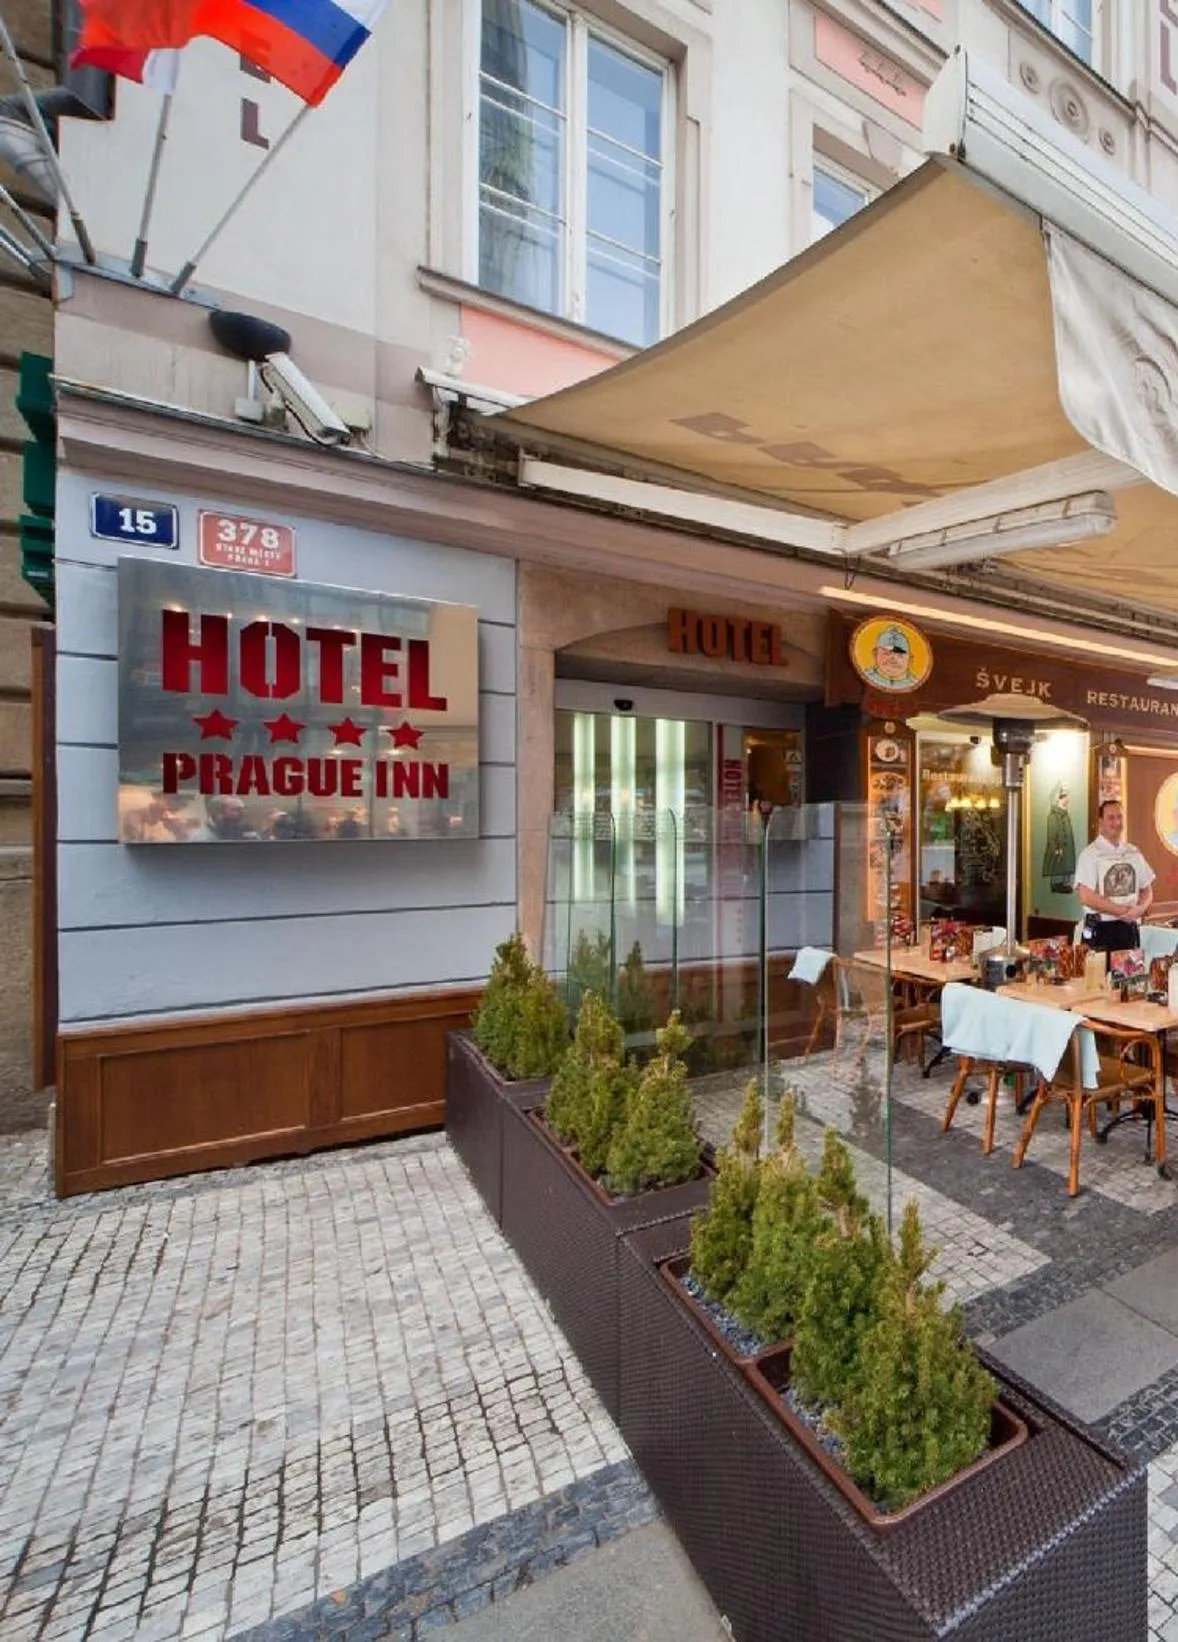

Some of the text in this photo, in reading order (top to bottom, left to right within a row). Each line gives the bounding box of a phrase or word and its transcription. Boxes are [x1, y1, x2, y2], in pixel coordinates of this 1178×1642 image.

[119, 508, 157, 534] 15
[217, 519, 280, 549] 378
[667, 607, 789, 667] HOTEL
[162, 609, 448, 711] HOTEL
[975, 667, 1052, 698] ŠVEJK
[162, 752, 450, 800] PRAGUE INN
